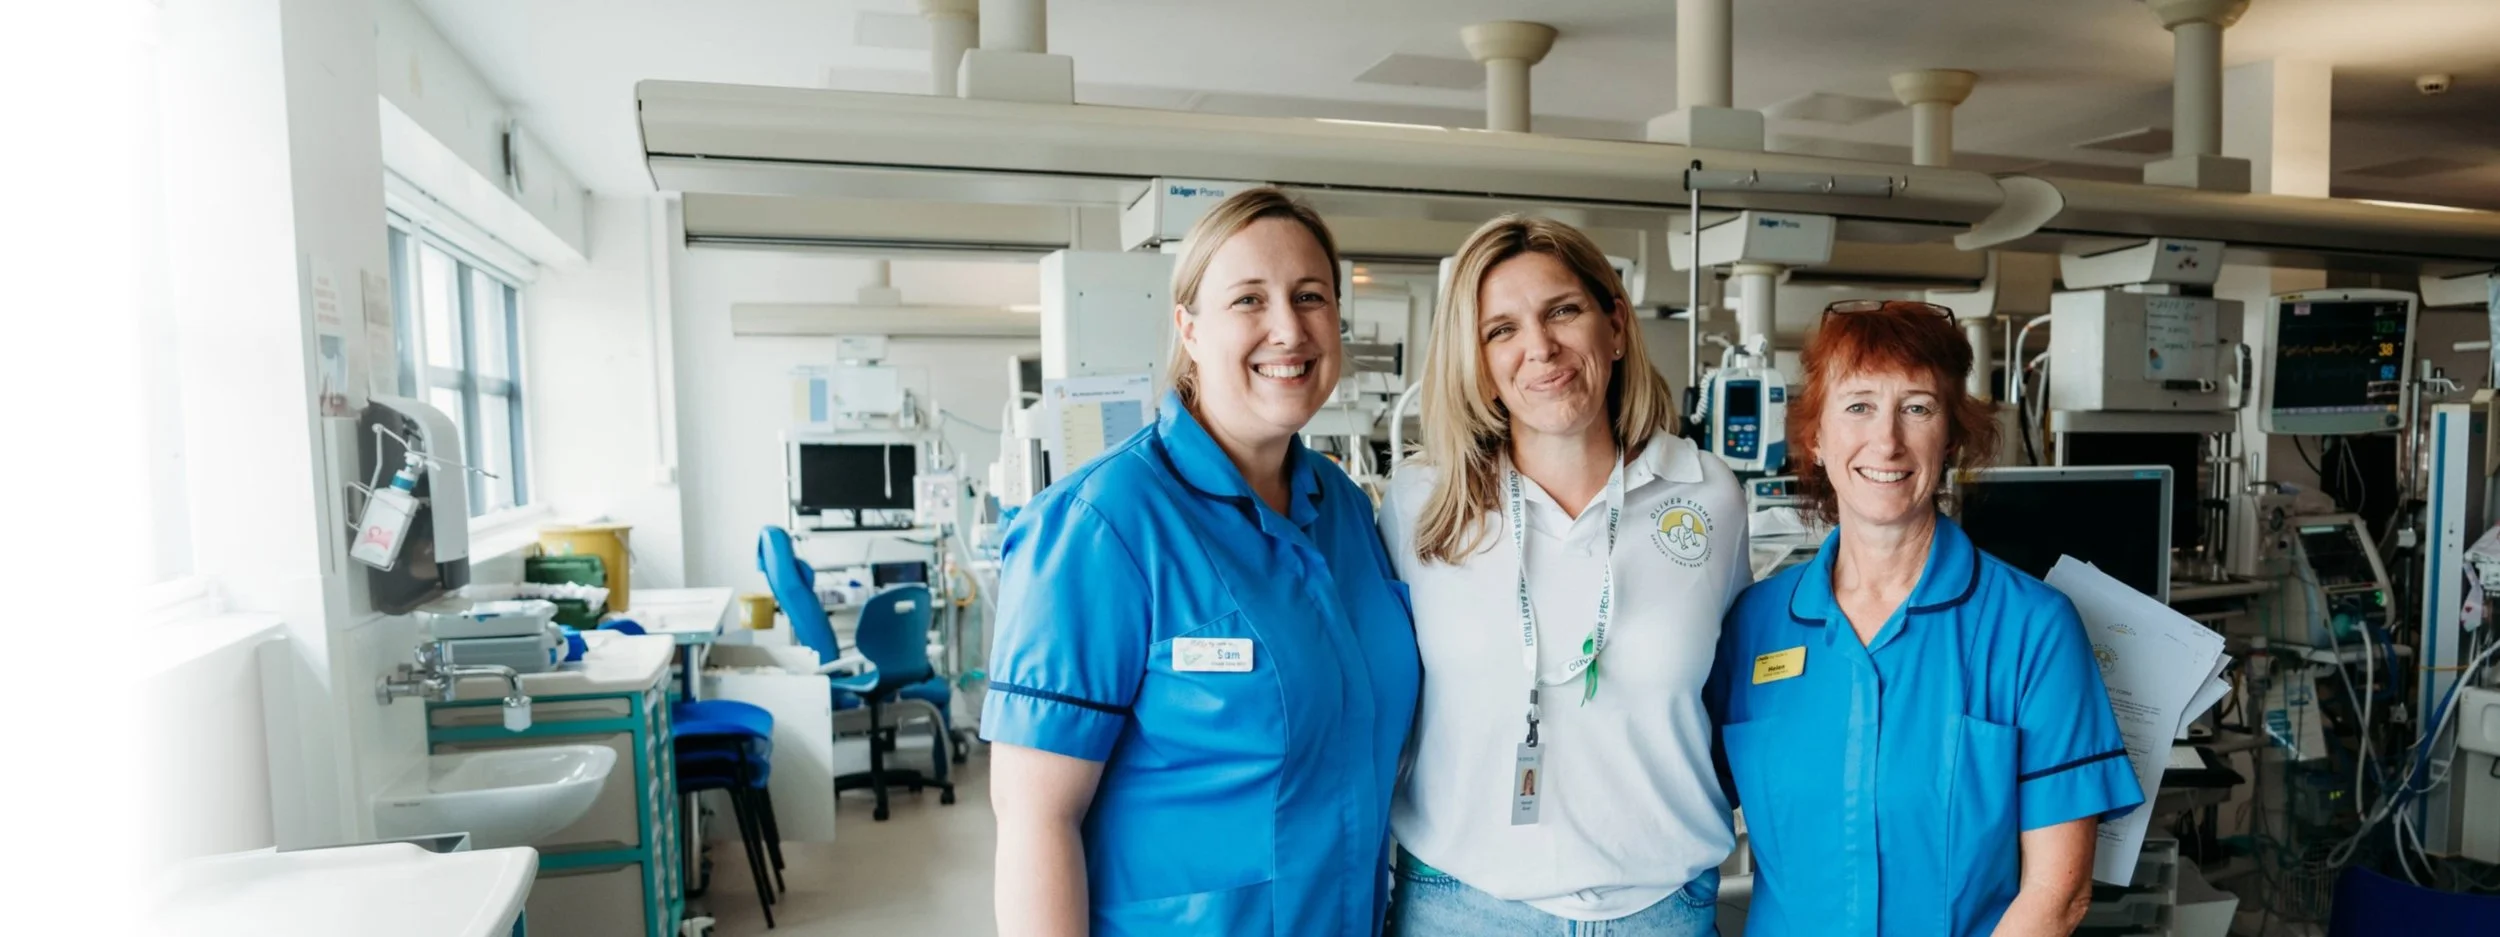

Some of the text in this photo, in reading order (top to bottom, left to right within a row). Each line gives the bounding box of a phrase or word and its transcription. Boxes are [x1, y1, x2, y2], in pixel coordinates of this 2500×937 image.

[2379, 343, 2394, 356] 38
[1510, 470, 1521, 499] OLIVER
[1512, 500, 1522, 529] FISHER
[1650, 498, 1713, 531] OLIVER FISHER
[1599, 582, 1611, 620] SPECIAL
[1609, 507, 1620, 532] TRUST
[1520, 595, 1531, 619] BABY
[1523, 621, 1534, 647] TRUST
[1217, 649, 1240, 659] Sam
